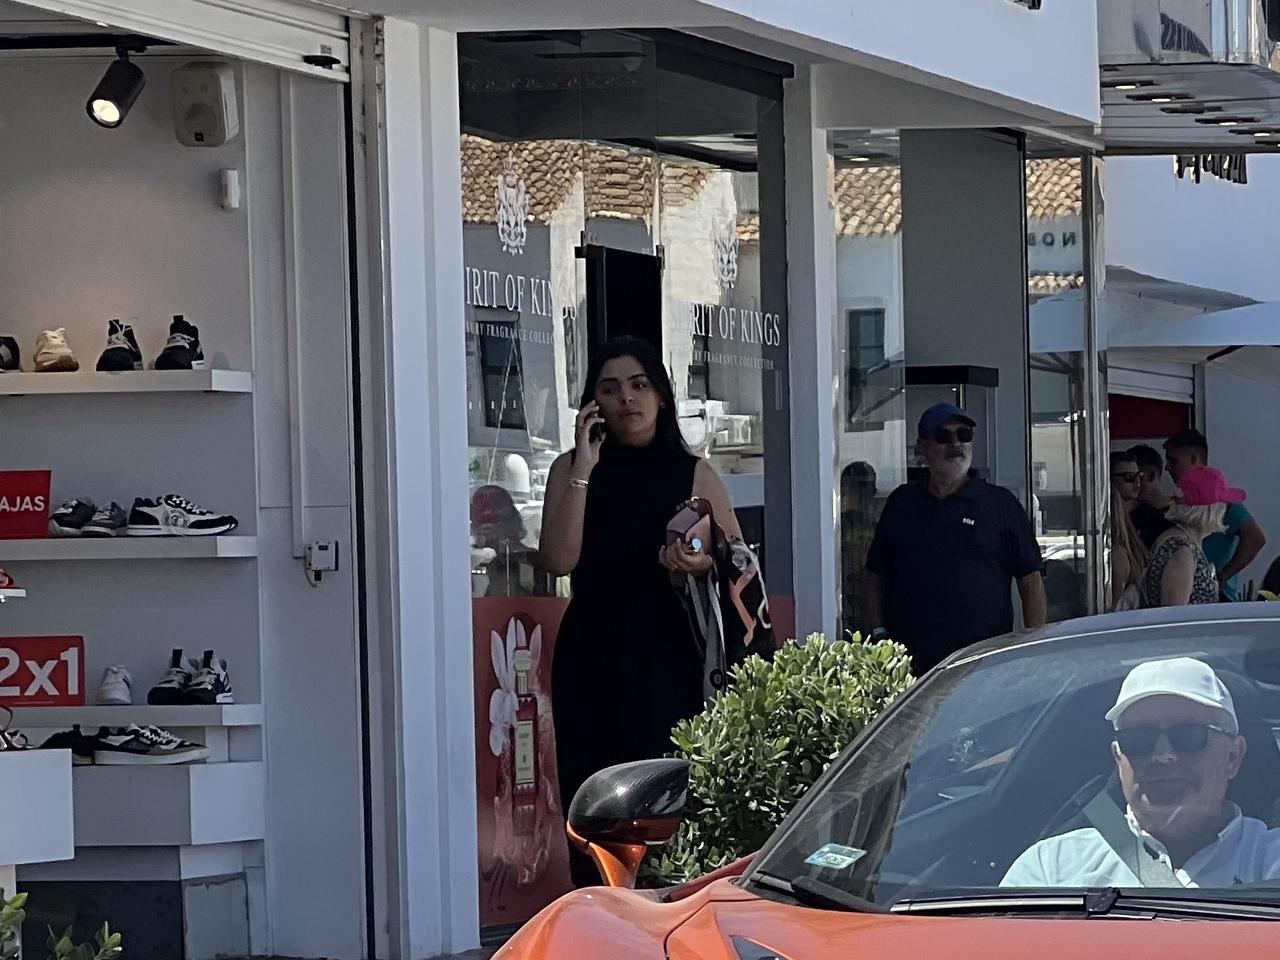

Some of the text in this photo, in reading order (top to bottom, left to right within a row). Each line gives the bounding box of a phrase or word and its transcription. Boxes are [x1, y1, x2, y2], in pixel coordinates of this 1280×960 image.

[504, 273, 526, 313] OF
[719, 305, 737, 340] OF
[741, 308, 781, 347] KINGS
[0, 495, 45, 512] AJAS
[0, 646, 79, 697] 2x1
